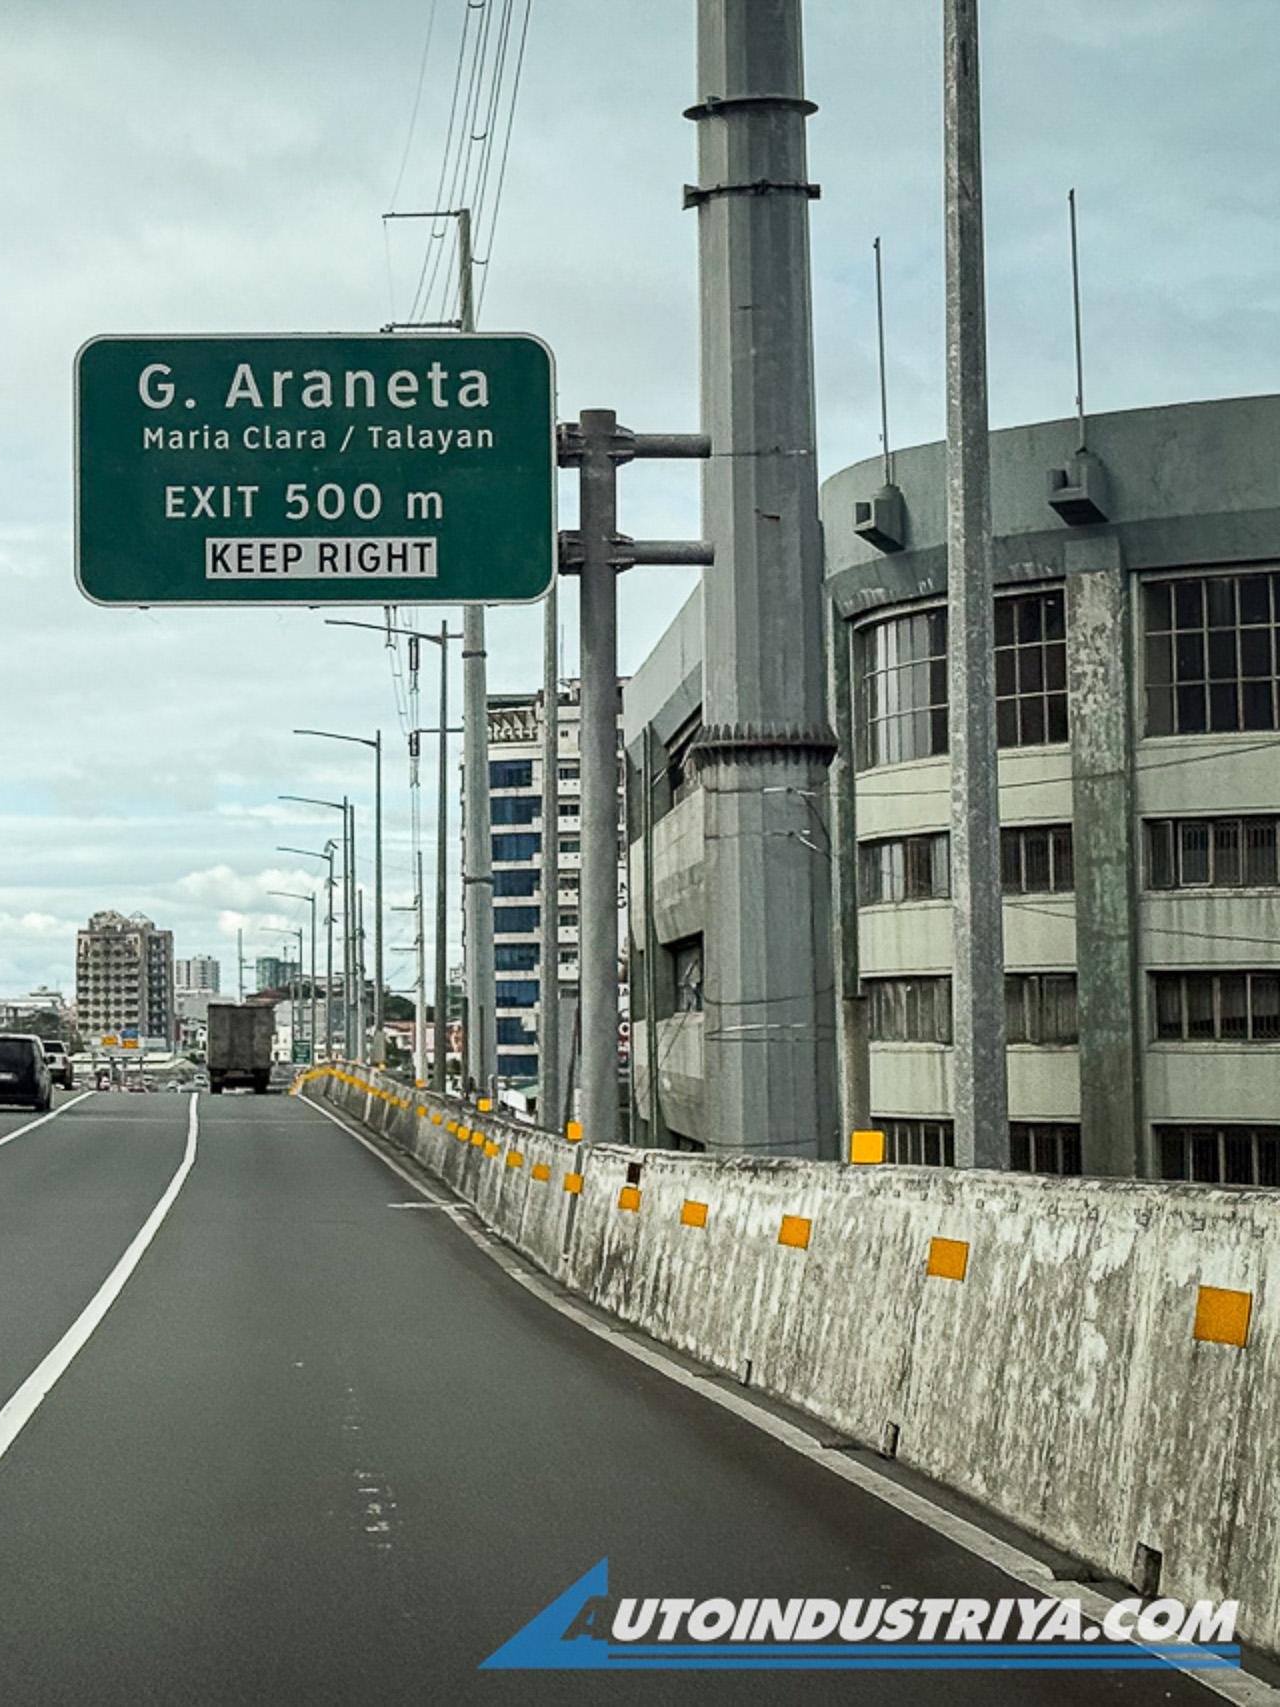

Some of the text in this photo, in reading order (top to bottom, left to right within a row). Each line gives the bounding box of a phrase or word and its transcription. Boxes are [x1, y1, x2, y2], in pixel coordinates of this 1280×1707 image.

[138, 361, 489, 409] G. Araneta
[143, 424, 493, 454] Maria Clara / Talayan
[165, 483, 443, 520] EXIT 500 m
[211, 542, 433, 573] KEEP RIGHT
